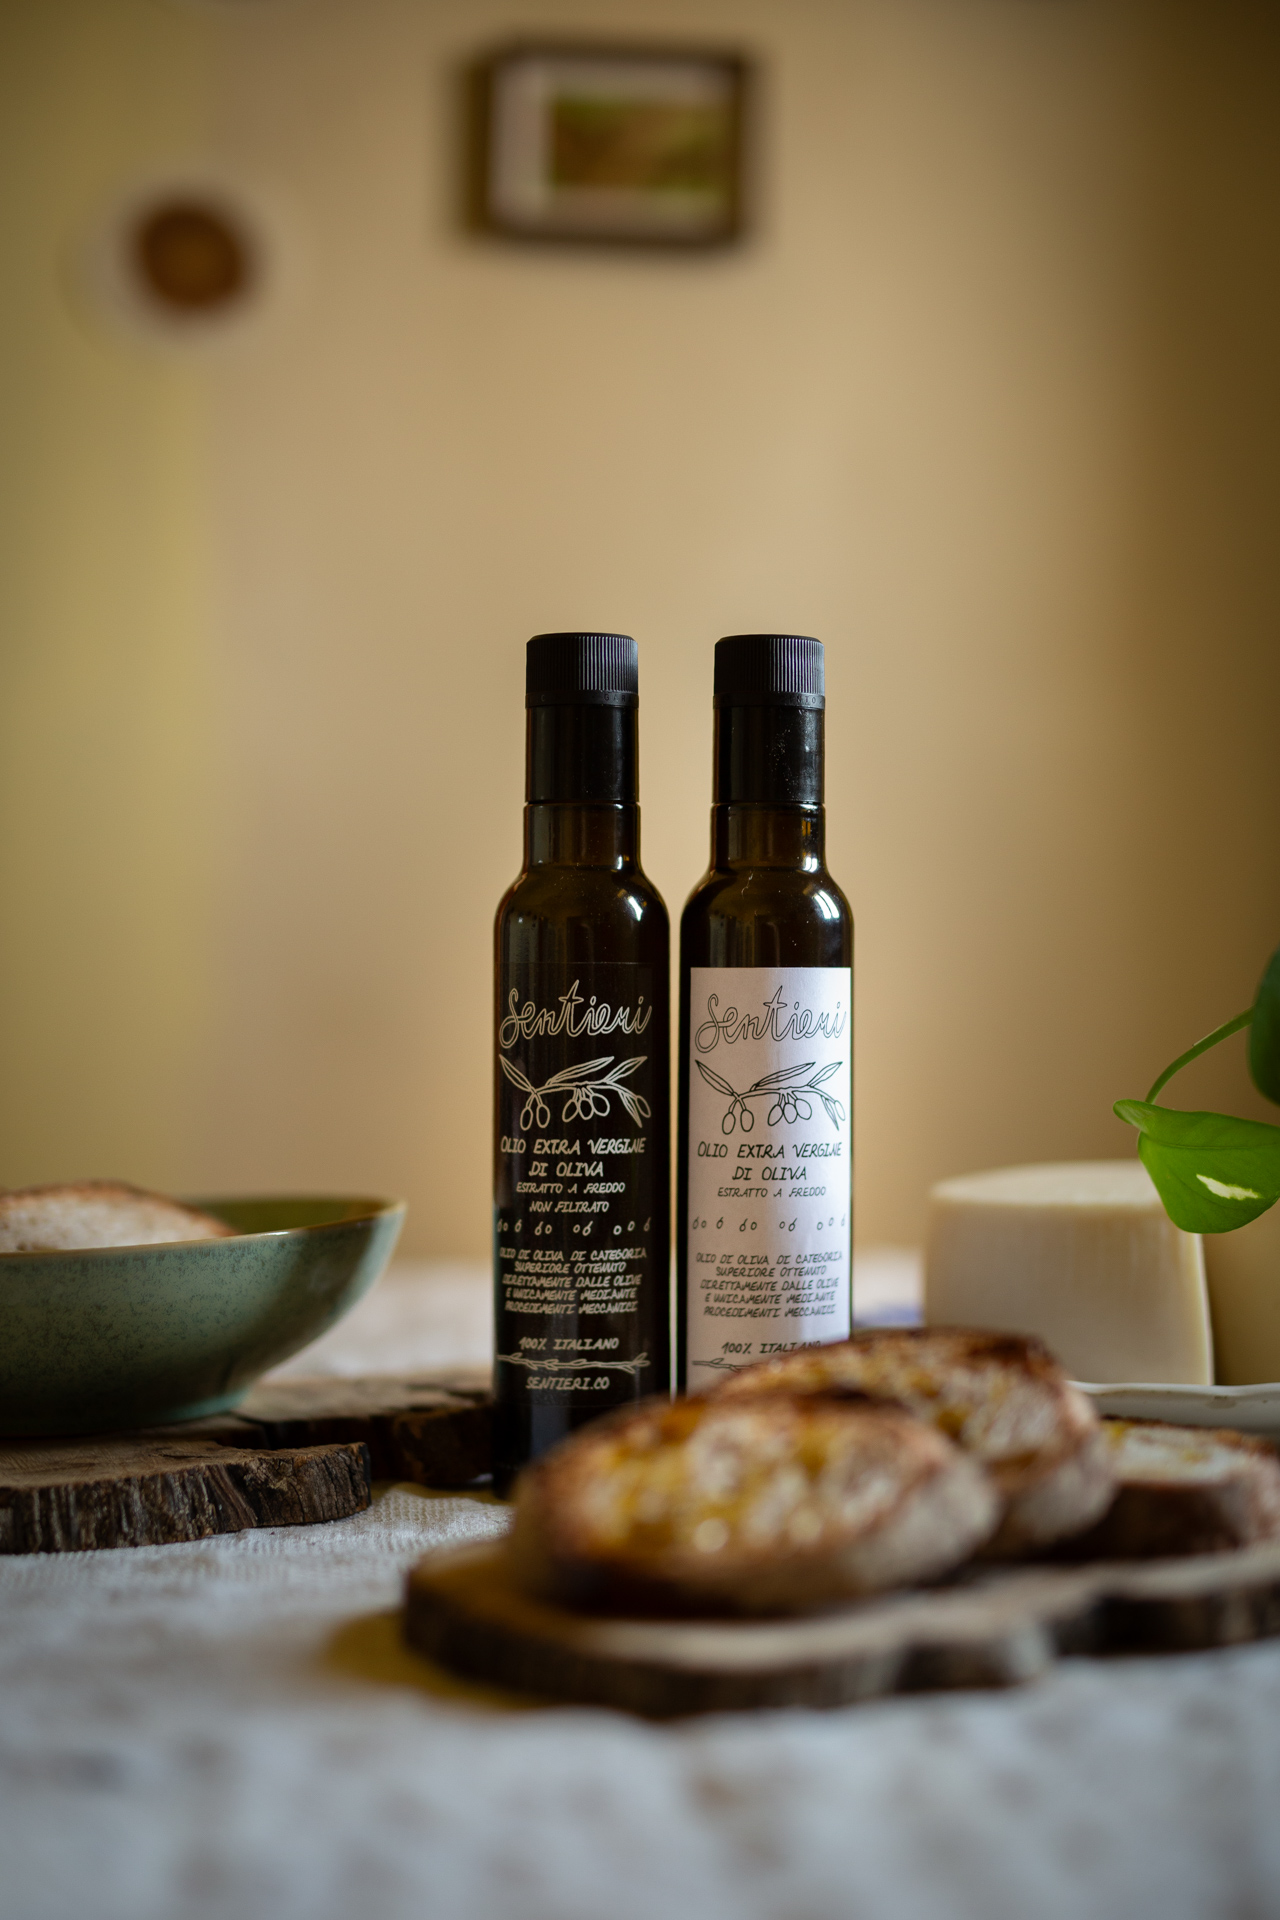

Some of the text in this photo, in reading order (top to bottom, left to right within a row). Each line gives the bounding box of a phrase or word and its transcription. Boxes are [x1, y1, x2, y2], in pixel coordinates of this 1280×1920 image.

[500, 980, 652, 1048] Sentieri
[695, 985, 846, 1053] Sentieri
[500, 1136, 646, 1155] OLIO EXTRA VERGINE
[698, 1141, 842, 1158] OLIO EXTRA VERGINE
[528, 1161, 604, 1177] DI OLIVA
[732, 1166, 806, 1180] DI OLIVA
[516, 1182, 626, 1194] ESTRATTO A FREDDO
[718, 1186, 826, 1198] ESTRATTO A FREDDO
[529, 1201, 610, 1213] NON FILTRATO
[500, 1247, 647, 1261] OLIO DI OLIVA DI CATEGORIA
[696, 1251, 842, 1265] OLIO DI OLIVA DI CATEGORIA
[514, 1261, 626, 1274] SUPERIORE OTTENUTO
[716, 1266, 826, 1277] SUPERIORE OTTENUTO
[502, 1274, 642, 1288] DIRETTAMENTE DALLE OLIVE
[700, 1278, 839, 1291] DIRETTAMENTE DALLE OLIVE
[506, 1287, 638, 1300] E UNICAMENTE MEDIANTE
[705, 1290, 836, 1304] E UNICAMENTE MEDIANTE
[504, 1300, 638, 1314] PROCEDIMENTI MECCANICI
[704, 1304, 836, 1318] PROCEDIMENTI MECCANICI
[518, 1336, 619, 1350] 100% ITALIANO
[722, 1342, 752, 1354] 100%
[526, 1376, 610, 1390] SENTIERI.CO
